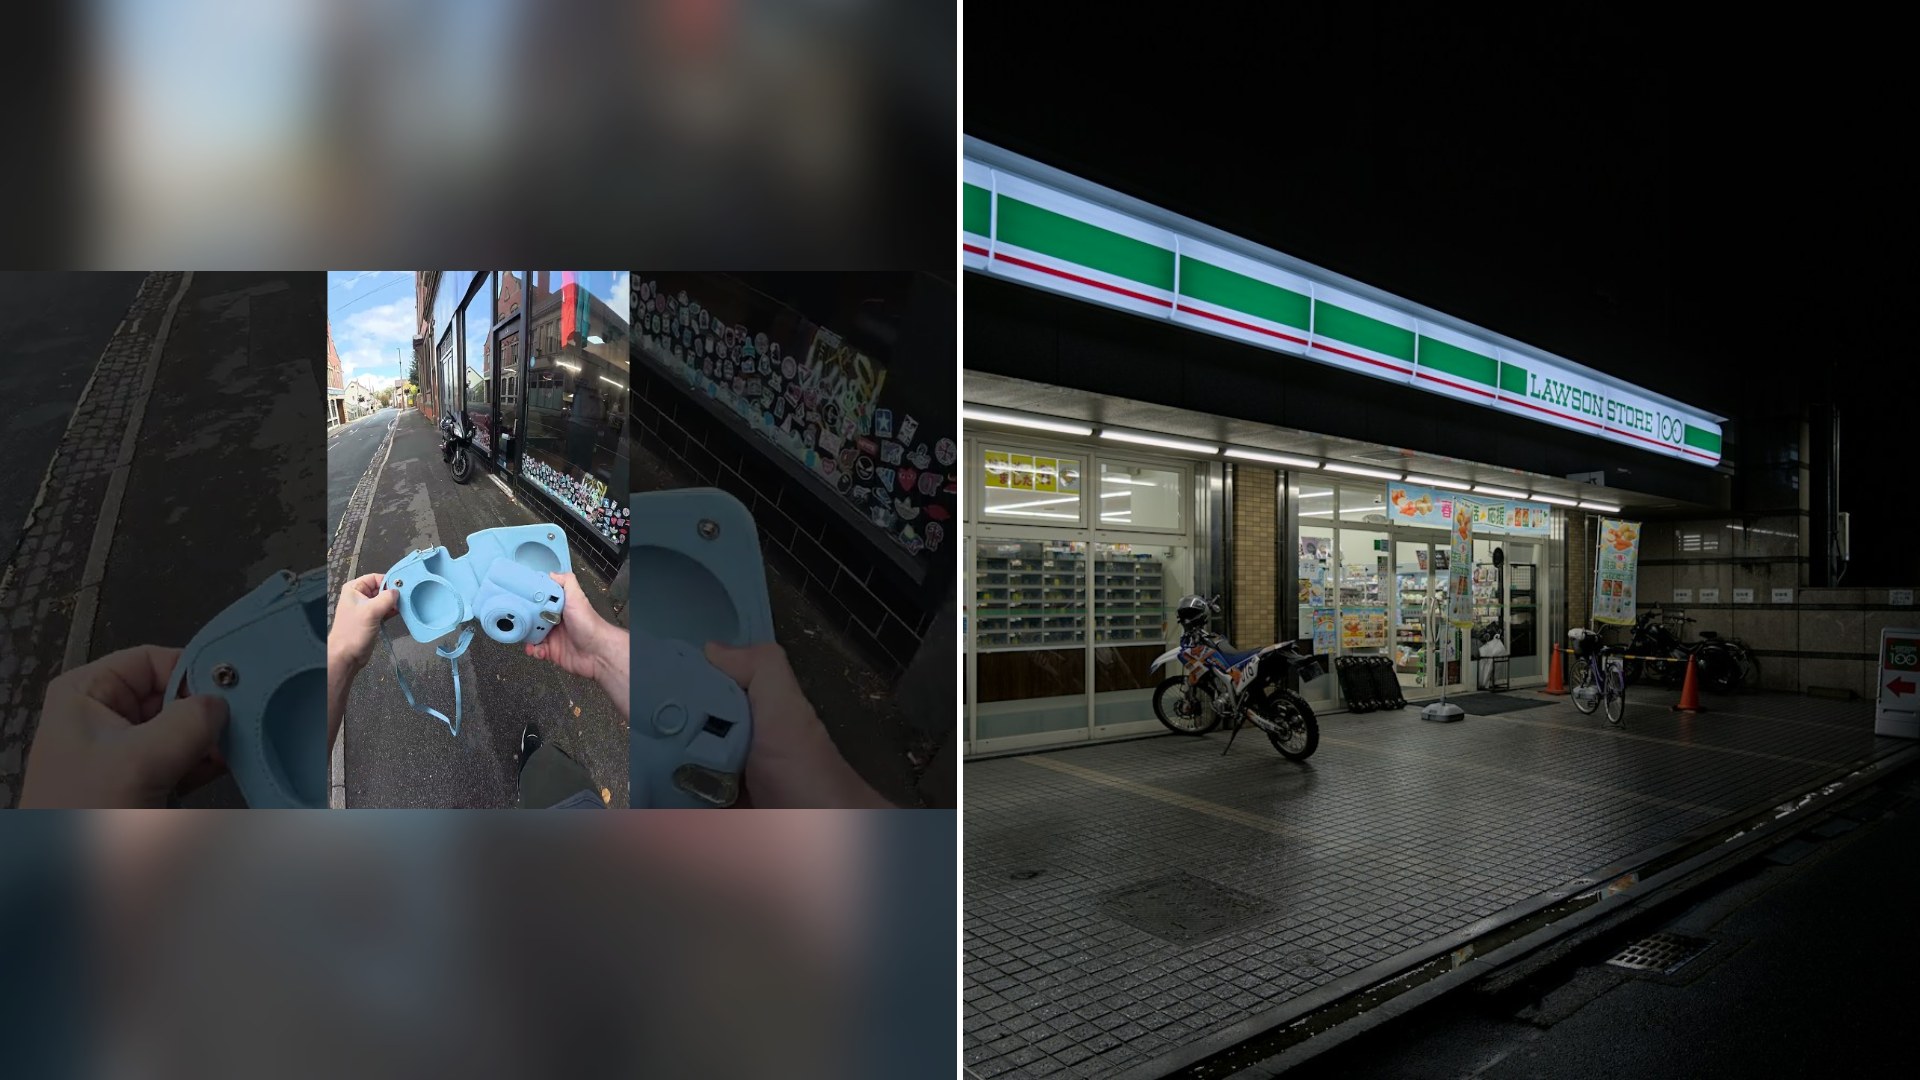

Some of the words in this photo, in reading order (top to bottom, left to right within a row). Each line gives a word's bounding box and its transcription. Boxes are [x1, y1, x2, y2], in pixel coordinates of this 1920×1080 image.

[1530, 373, 1604, 418] LAWSON
[1607, 399, 1653, 433] STORE
[1656, 411, 1683, 444] 100
[1889, 652, 1918, 666] 100
